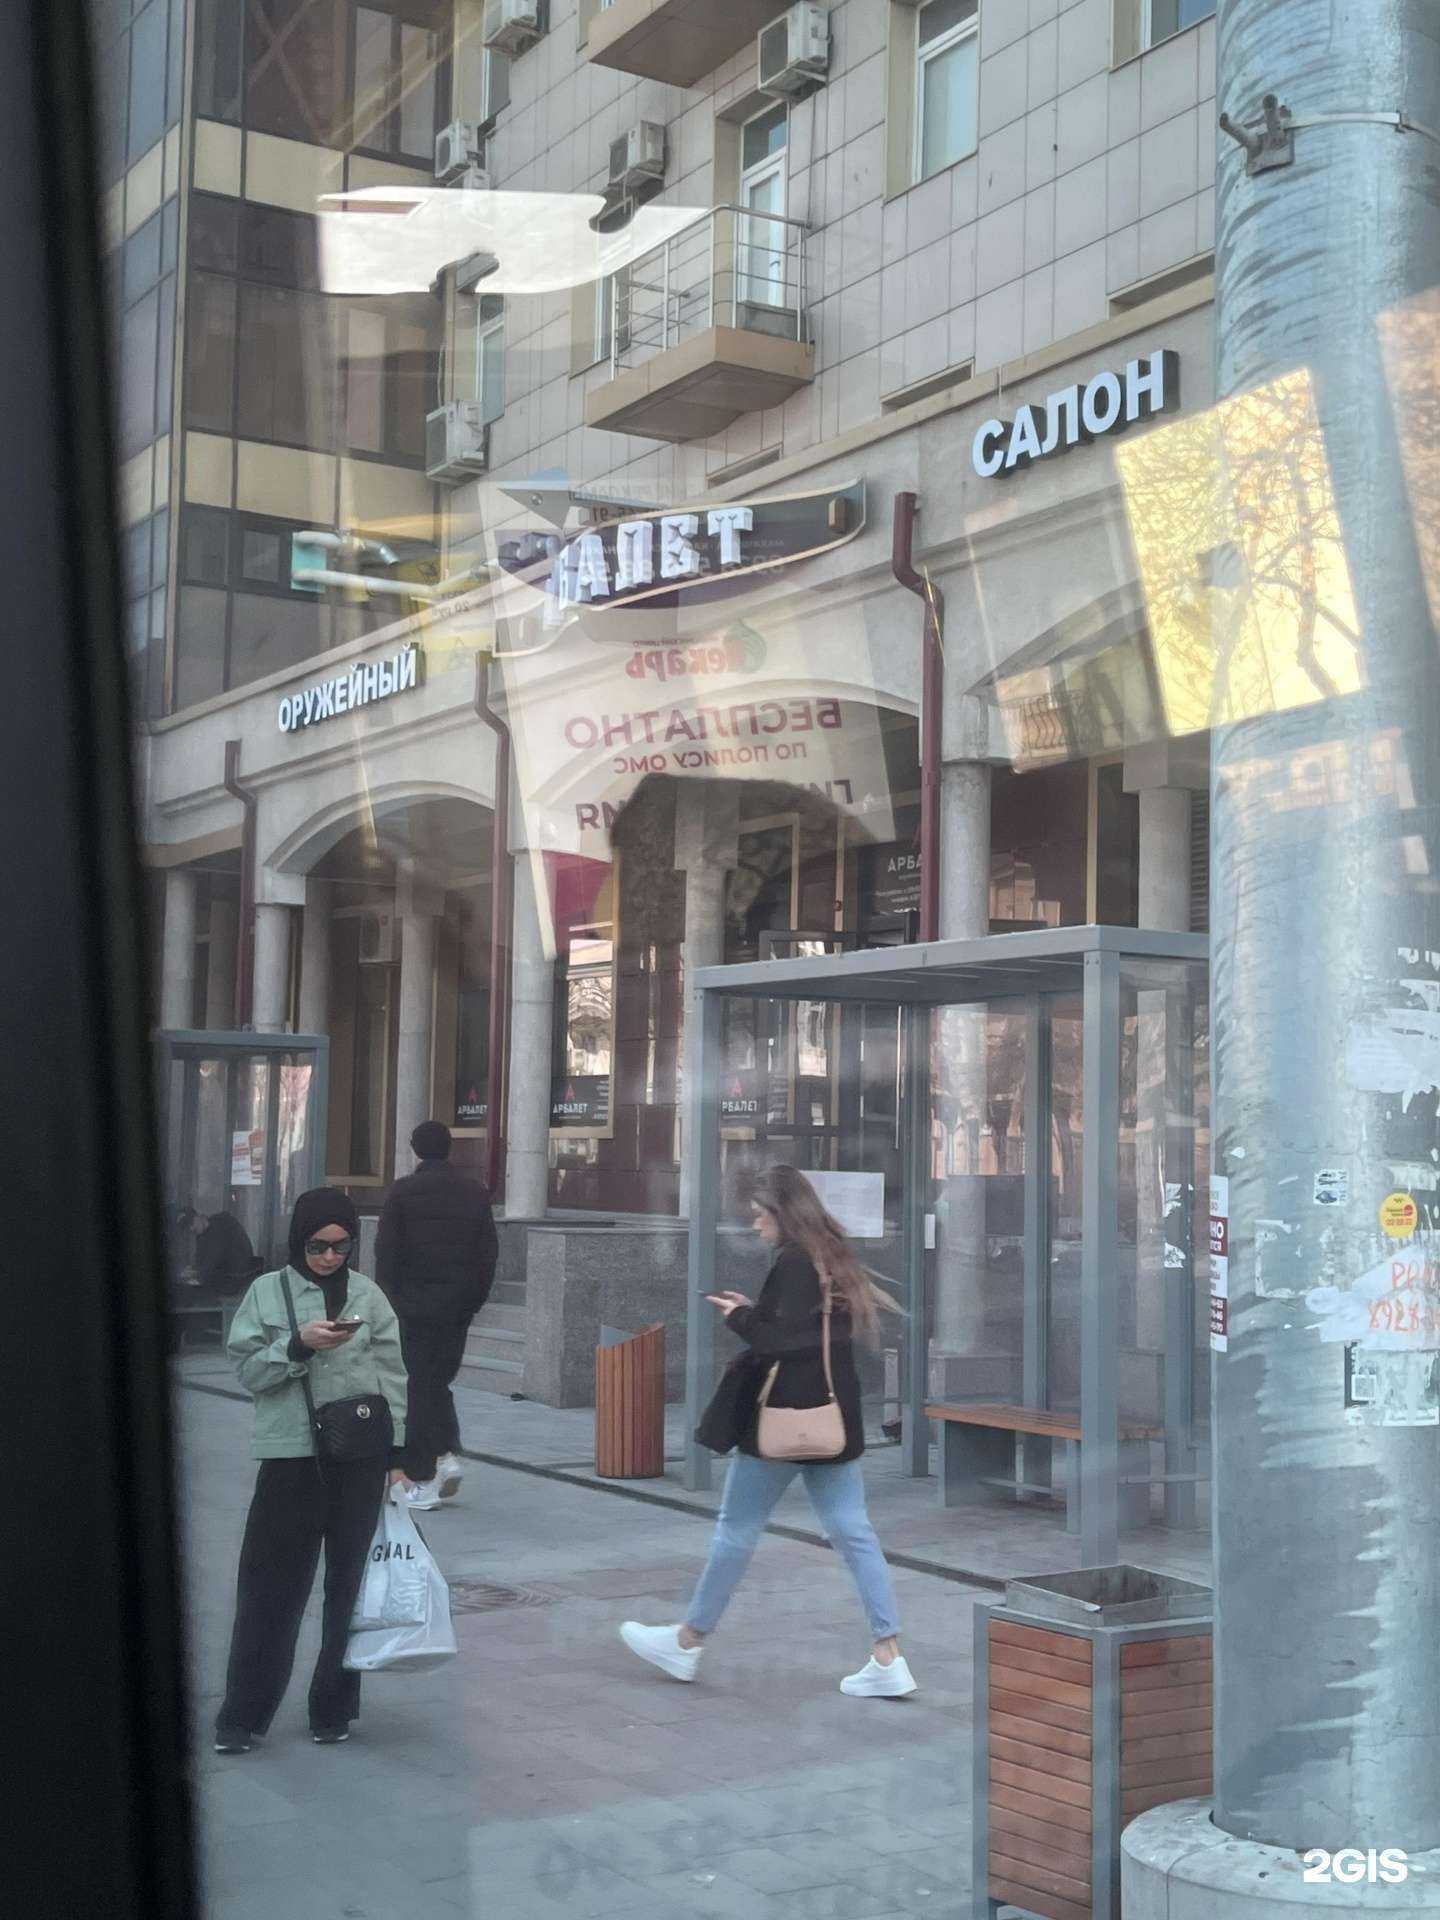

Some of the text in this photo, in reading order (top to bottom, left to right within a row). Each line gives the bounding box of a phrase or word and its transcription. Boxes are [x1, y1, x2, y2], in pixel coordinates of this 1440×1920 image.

[972, 350, 1166, 478] САЛОН
[277, 644, 418, 733] ОРУЖЕЙНЫЙ
[552, 1103, 588, 1114] АРБАЛЕТ
